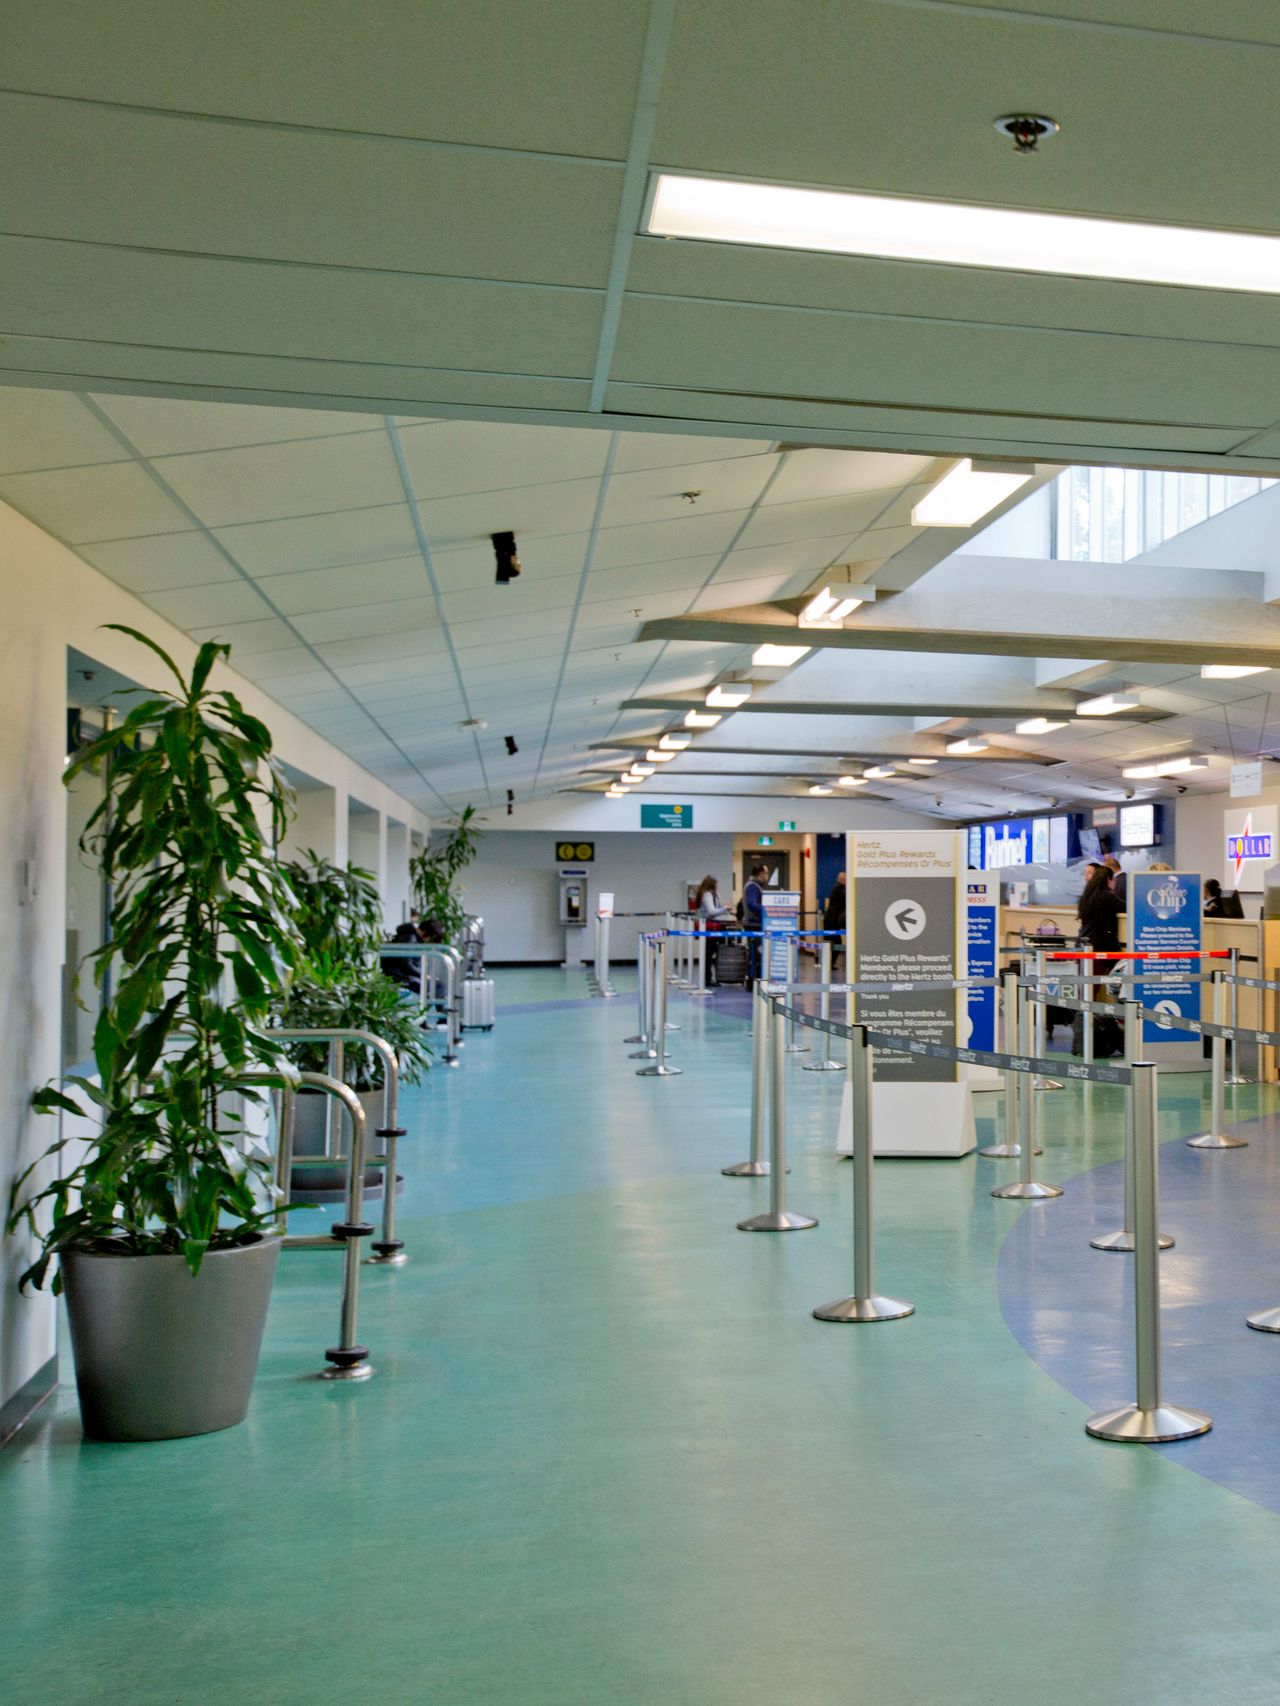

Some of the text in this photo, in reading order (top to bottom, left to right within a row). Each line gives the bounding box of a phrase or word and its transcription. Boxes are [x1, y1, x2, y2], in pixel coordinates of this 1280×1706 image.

[857, 841, 881, 849] Hertz
[1229, 837, 1271, 857] DOLLAR
[857, 850, 937, 859] Gold Plus Rewards
[932, 860, 952, 869] Plus
[860, 954, 881, 962] Hertz
[881, 954, 899, 962] Gold
[900, 954, 916, 962] Plus
[860, 964, 952, 973] Members, please proceed
[860, 973, 888, 982] directly
[888, 973, 897, 981] to
[897, 973, 910, 981] the
[911, 973, 932, 981] Hertz
[829, 983, 852, 992] Hertz
[860, 1010, 869, 1018] Si
[888, 1010, 904, 1018] êtes
[904, 1010, 935, 1018] membre
[936, 1010, 947, 1018] du
[903, 1018, 954, 1028] Récompenses
[915, 1028, 943, 1036] veuillez
[909, 1041, 927, 1056] Hertz
[1010, 1057, 1030, 1072] Hertz
[1067, 1063, 1089, 1079] Hertz
